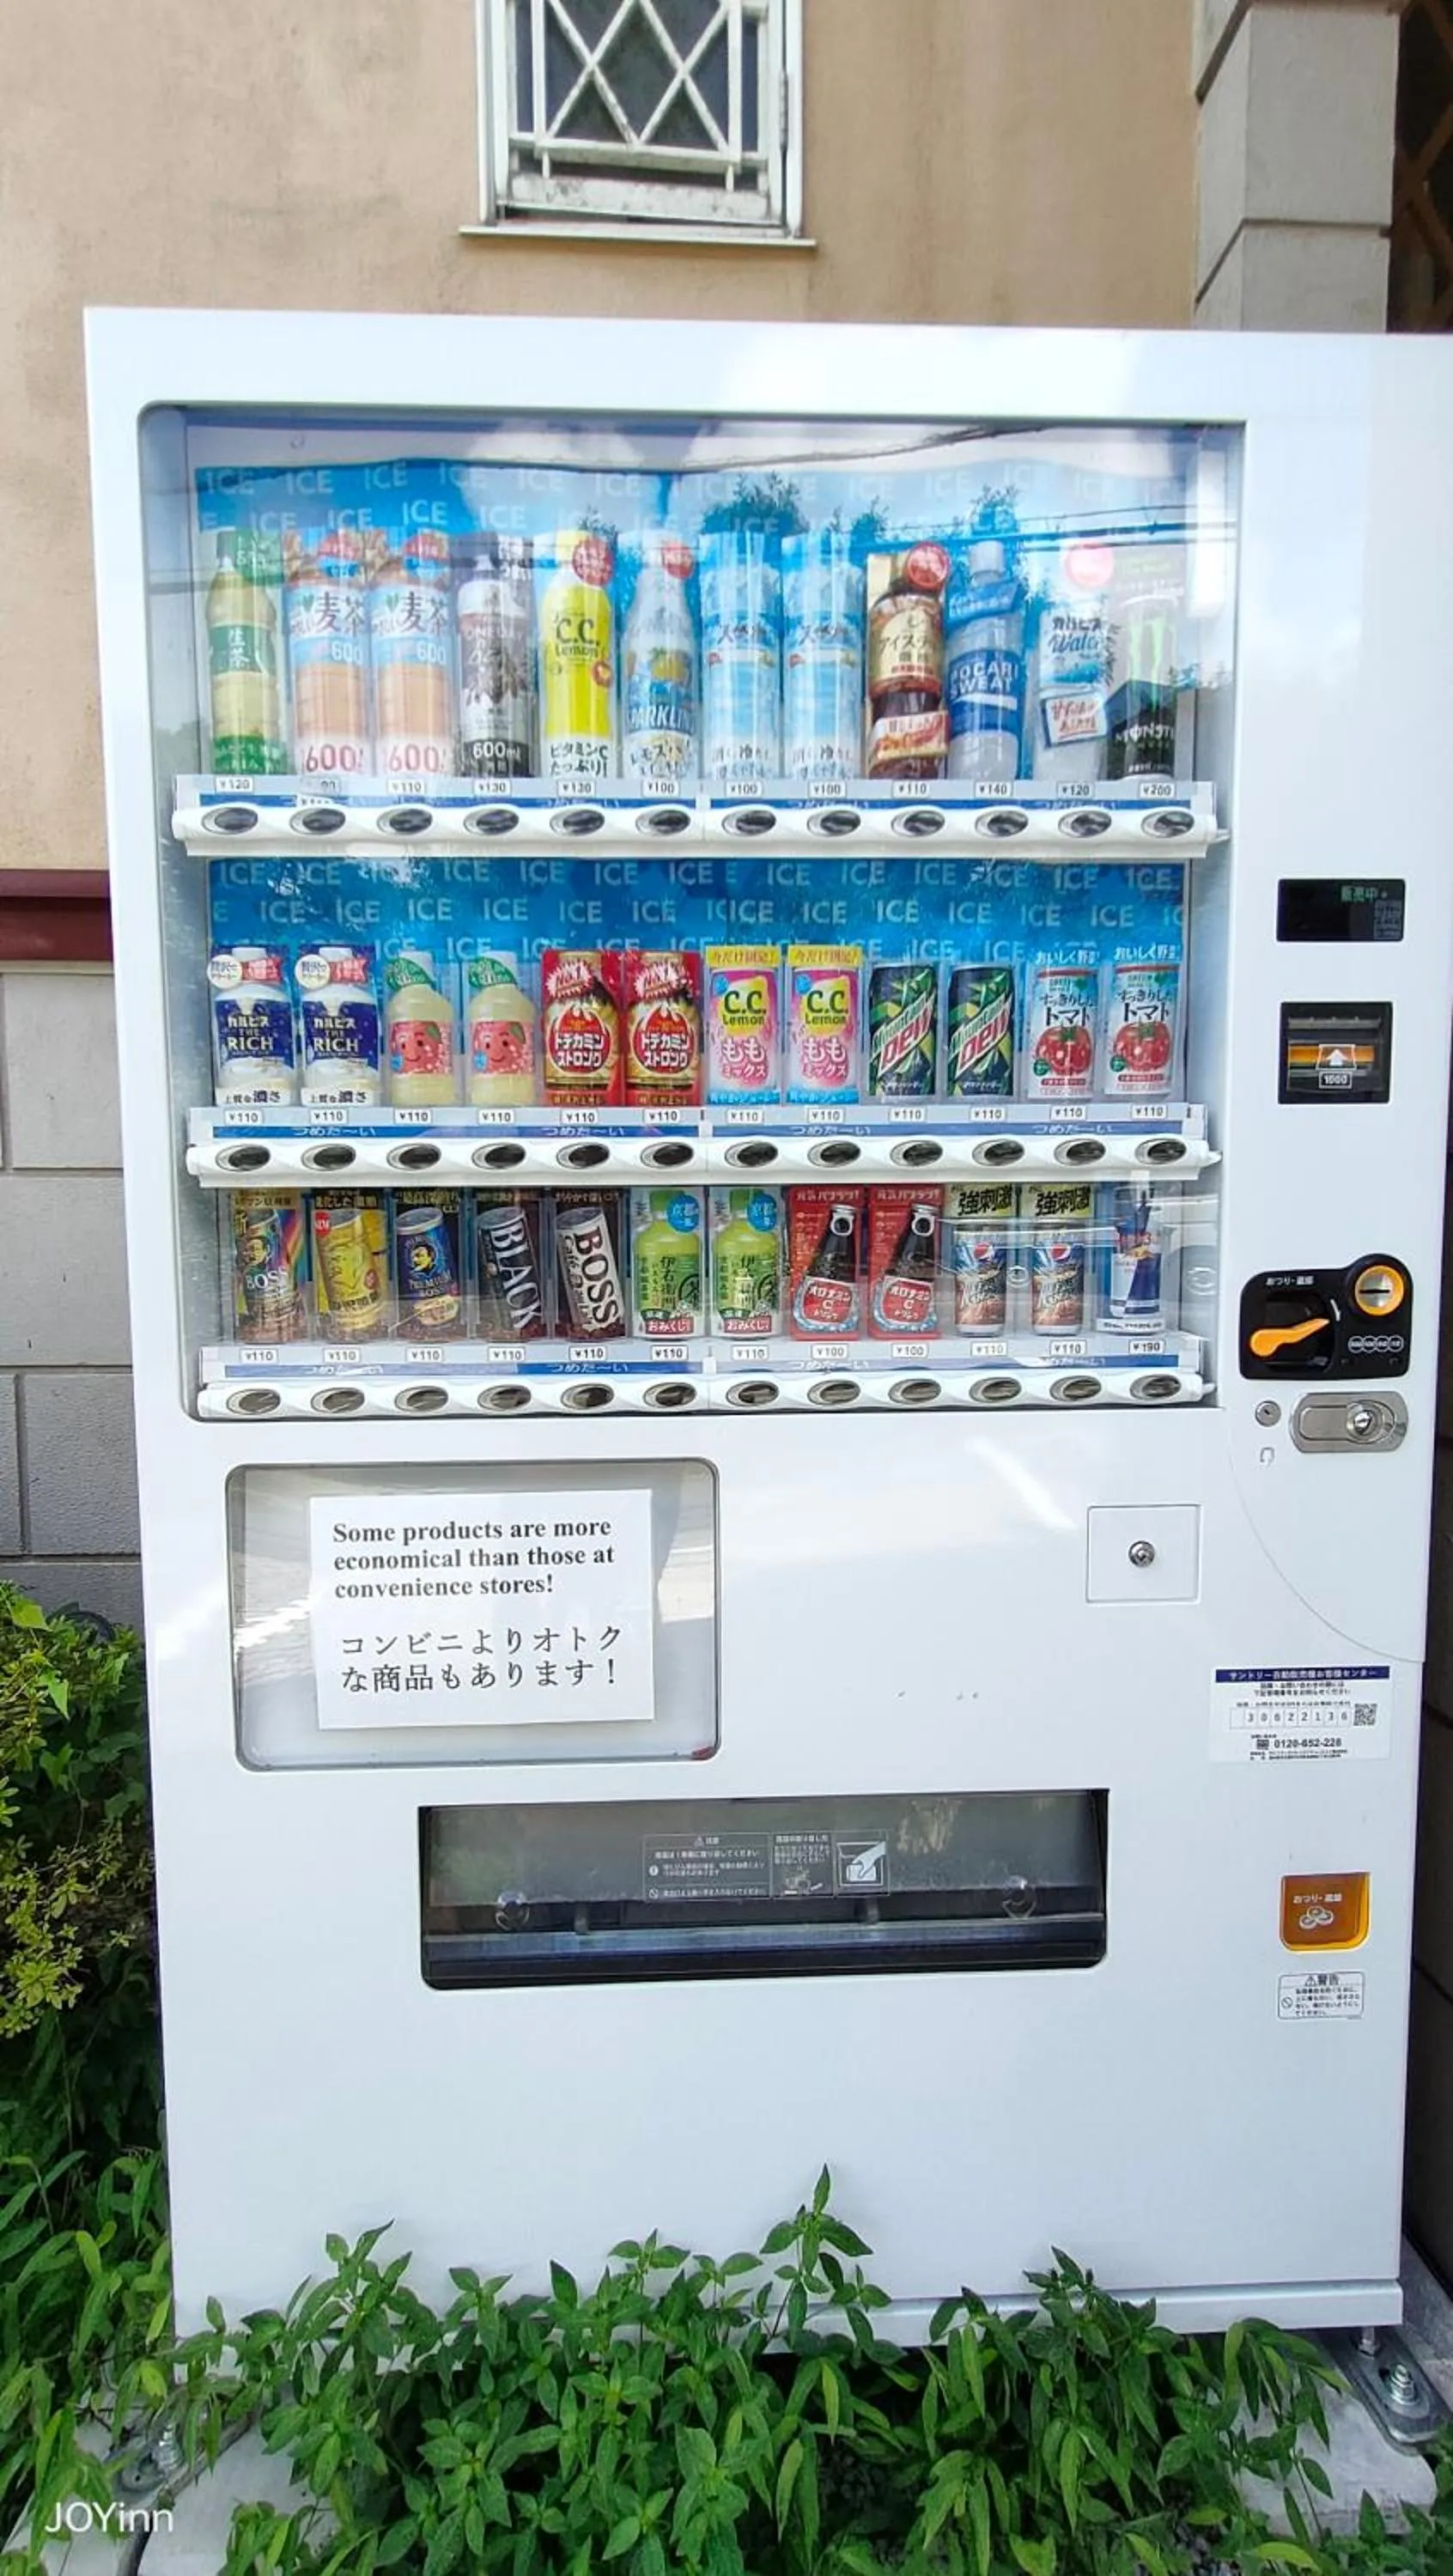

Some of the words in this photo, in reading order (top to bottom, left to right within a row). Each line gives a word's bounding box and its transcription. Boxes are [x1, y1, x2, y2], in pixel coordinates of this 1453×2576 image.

[364, 462, 408, 490] ICE
[327, 507, 373, 529] ICE
[403, 501, 449, 526] ICE
[479, 506, 528, 529] ICE
[315, 591, 364, 637] 麦茶
[401, 591, 450, 637] 麦茶
[331, 641, 363, 663] 600
[416, 642, 447, 663] 600
[951, 663, 1019, 682] POCARI
[951, 678, 1012, 701] SWEAT
[550, 744, 609, 760] ビタミンC
[899, 784, 927, 793] ¥110
[444, 860, 490, 882] ICE
[520, 861, 564, 884] ICE
[594, 862, 639, 885] ICE
[669, 862, 714, 885] ICE
[767, 863, 811, 885] ICE
[842, 861, 885, 885] ICE
[915, 863, 957, 885] ICE
[1054, 866, 1099, 890] ICE
[1127, 867, 1172, 890] ICE
[336, 899, 381, 923] ICE
[408, 898, 453, 921] ICE
[483, 898, 529, 921] ICE
[559, 901, 602, 924] ICE
[632, 900, 677, 923] ICE
[730, 900, 775, 924] ICE
[803, 901, 848, 924] ICE
[876, 899, 920, 923] ICE
[949, 902, 993, 925] ICE
[1022, 904, 1062, 927] ICE
[1091, 904, 1134, 927] ICE
[447, 938, 492, 959] ICE
[724, 990, 766, 1014] C.C.
[806, 990, 848, 1014] C.C.
[1123, 1002, 1170, 1023] トマト
[228, 1016, 271, 1028] カルピス
[313, 1017, 356, 1028] カルピス
[722, 1013, 765, 1025] Lemon
[805, 1013, 847, 1025] Lemon
[1046, 1006, 1091, 1027] トマト
[227, 1037, 274, 1051] RICH
[313, 1038, 359, 1052] RICH
[723, 1036, 767, 1063] もも
[803, 1036, 847, 1063] もも
[722, 1064, 768, 1079] ミックス
[1323, 1074, 1348, 1084] 1000
[230, 1112, 258, 1122] ¥110
[314, 1110, 343, 1121] ¥110
[400, 1111, 429, 1121] ¥110
[483, 1112, 511, 1122] ¥110
[566, 1112, 595, 1123] ¥110
[649, 1111, 678, 1121] ¥110
[730, 1111, 758, 1121] ¥110
[811, 1111, 840, 1121] ¥110
[894, 1109, 921, 1120] ¥110
[975, 1109, 1002, 1120] ¥110
[1055, 1108, 1083, 1118] ¥110
[1136, 1107, 1164, 1117] ¥110
[246, 1267, 289, 1290] BOSS
[489, 1220, 543, 1329] BLACK
[575, 1225, 620, 1325] BOSS
[246, 1351, 274, 1361] ¥110
[328, 1351, 356, 1361] ¥110
[411, 1351, 440, 1361] ¥110
[493, 1350, 521, 1360] ¥110
[575, 1347, 604, 1358] ¥110
[655, 1347, 683, 1358] ¥110
[737, 1348, 764, 1358] ¥110
[817, 1347, 844, 1358] ¥100
[897, 1346, 924, 1356] ¥100
[976, 1345, 1004, 1355] ¥110
[1055, 1344, 1081, 1354] ¥110
[332, 1522, 395, 1543] Some
[403, 1520, 503, 1546] products
[510, 1522, 546, 1539] are
[553, 1519, 612, 1538] more
[333, 1548, 461, 1571] economical
[469, 1547, 520, 1567] than
[527, 1546, 586, 1566] those
[593, 1545, 616, 1564] at
[335, 1577, 473, 1599] convenience
[480, 1574, 555, 1595] stores!
[342, 1625, 622, 1656] コンビニよりオトク
[342, 1658, 616, 1693] な商品もあります！
